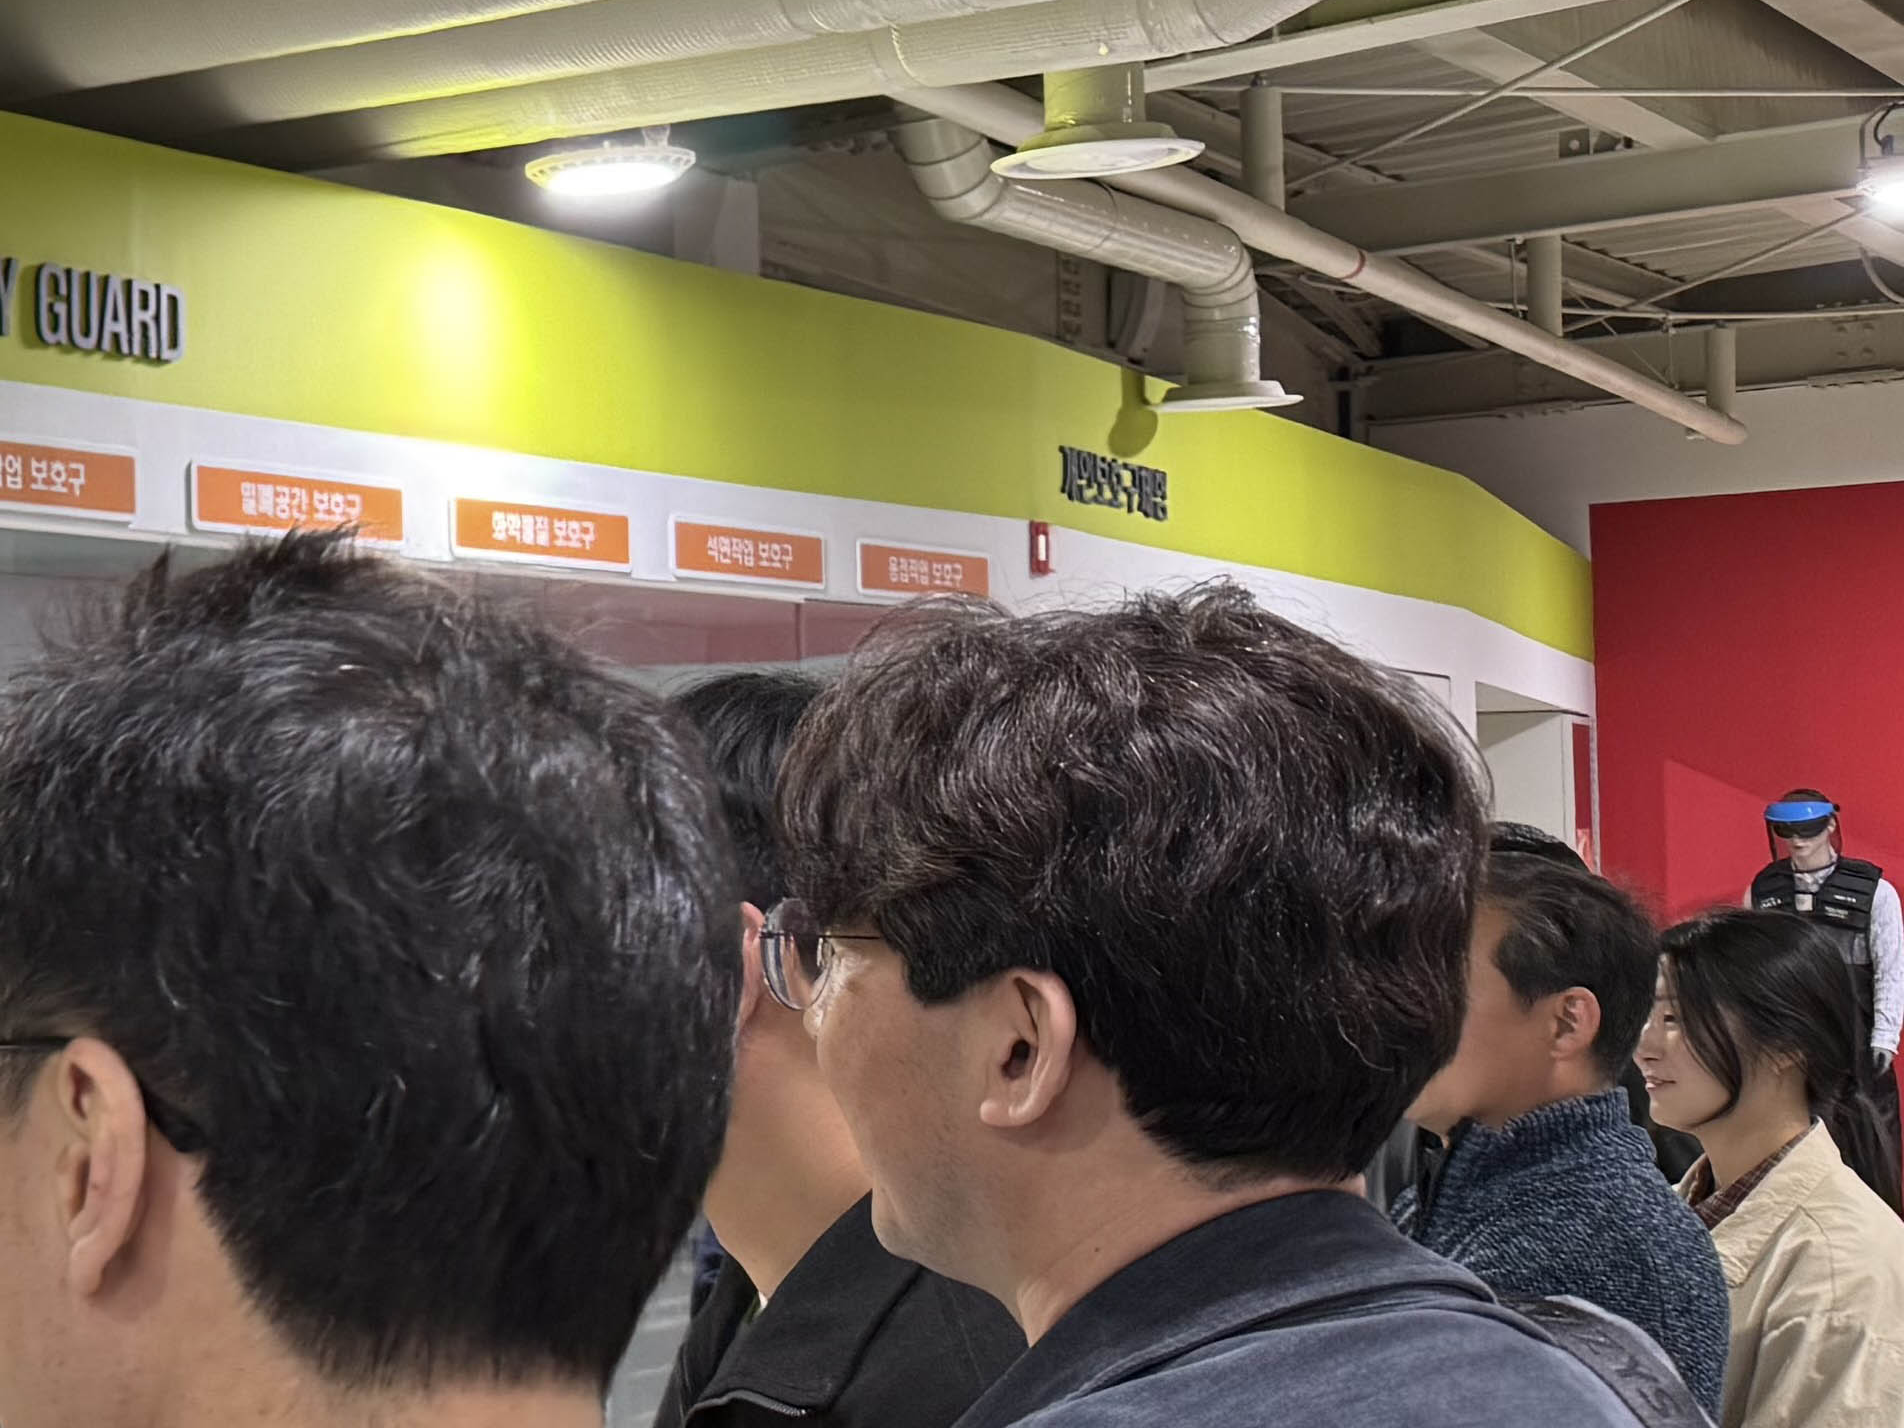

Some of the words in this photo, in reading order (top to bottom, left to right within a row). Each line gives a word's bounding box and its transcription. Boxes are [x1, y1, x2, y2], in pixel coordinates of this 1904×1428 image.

[36, 262, 186, 363] GUARD
[30, 457, 86, 497] 보호구
[313, 490, 362, 523] 보호구
[553, 518, 596, 550] 보호구
[758, 542, 793, 570] 보호구
[933, 563, 962, 588] 보호구
